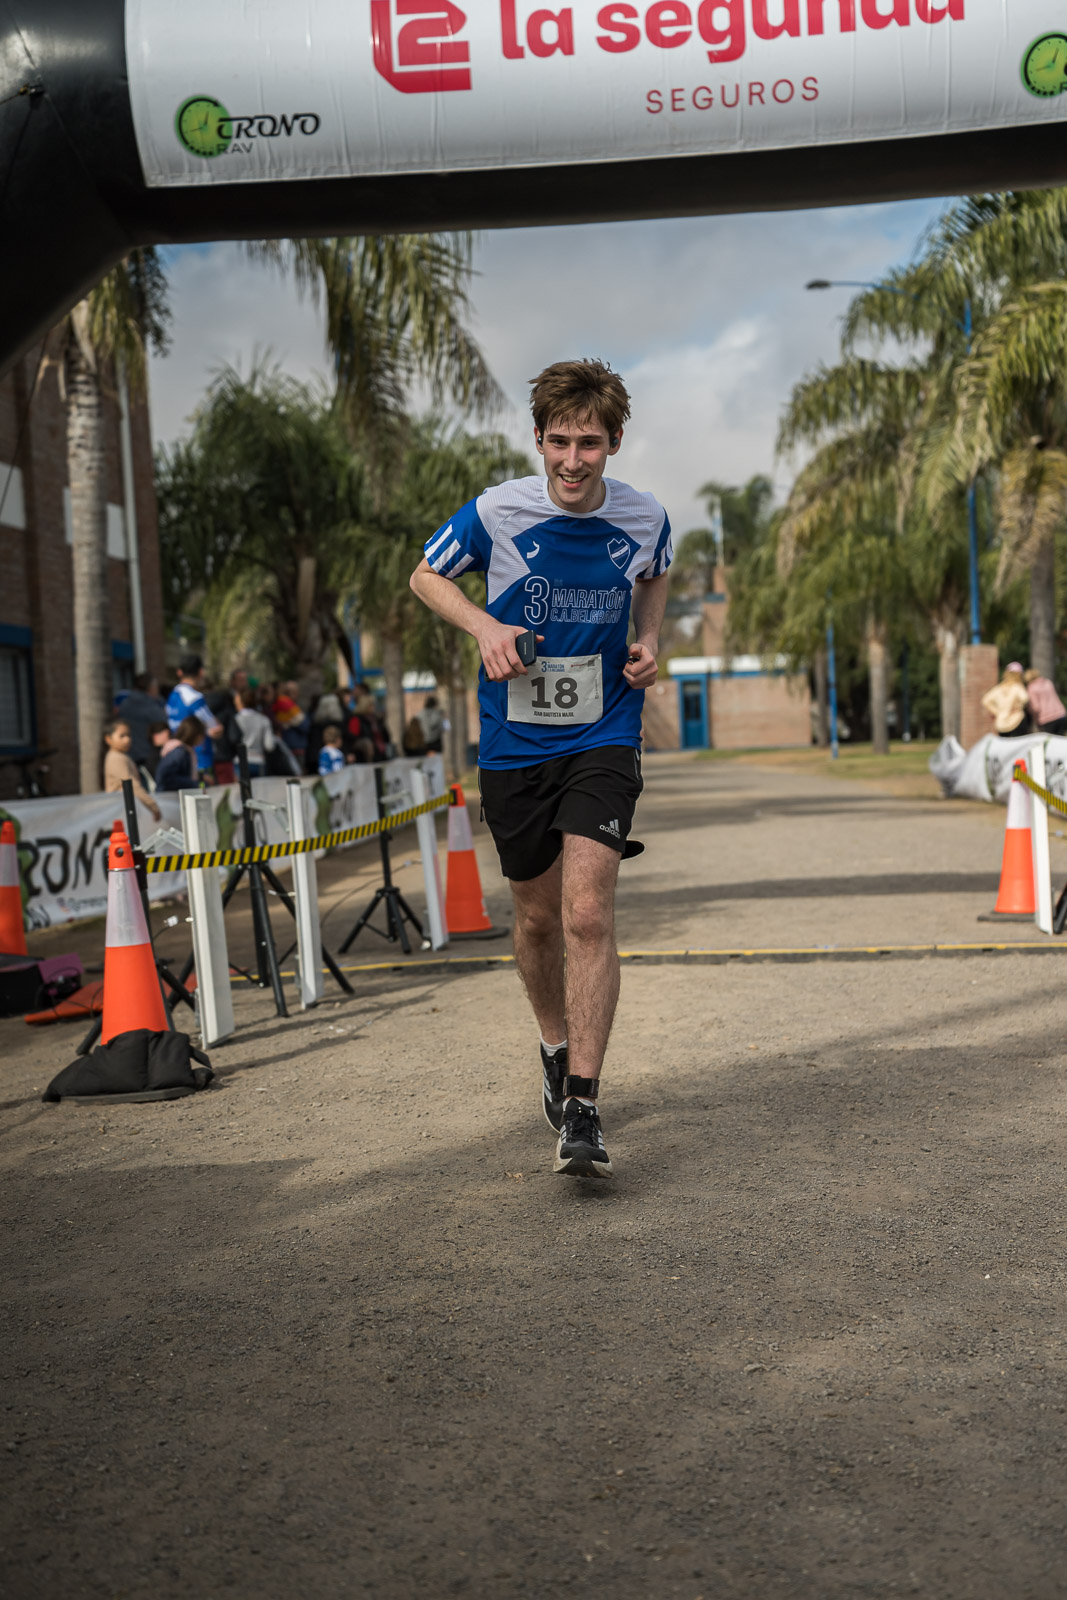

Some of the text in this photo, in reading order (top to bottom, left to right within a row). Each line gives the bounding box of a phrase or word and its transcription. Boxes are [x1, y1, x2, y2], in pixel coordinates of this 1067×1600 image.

[500, 0, 575, 60] la
[645, 76, 819, 114] SEGUROS
[217, 113, 321, 139] CRONO
[216, 142, 254, 154] RAV
[524, 575, 550, 625] 3
[551, 586, 627, 610] MARATÓN
[531, 676, 579, 709] 18
[599, 824, 621, 839] adidas
